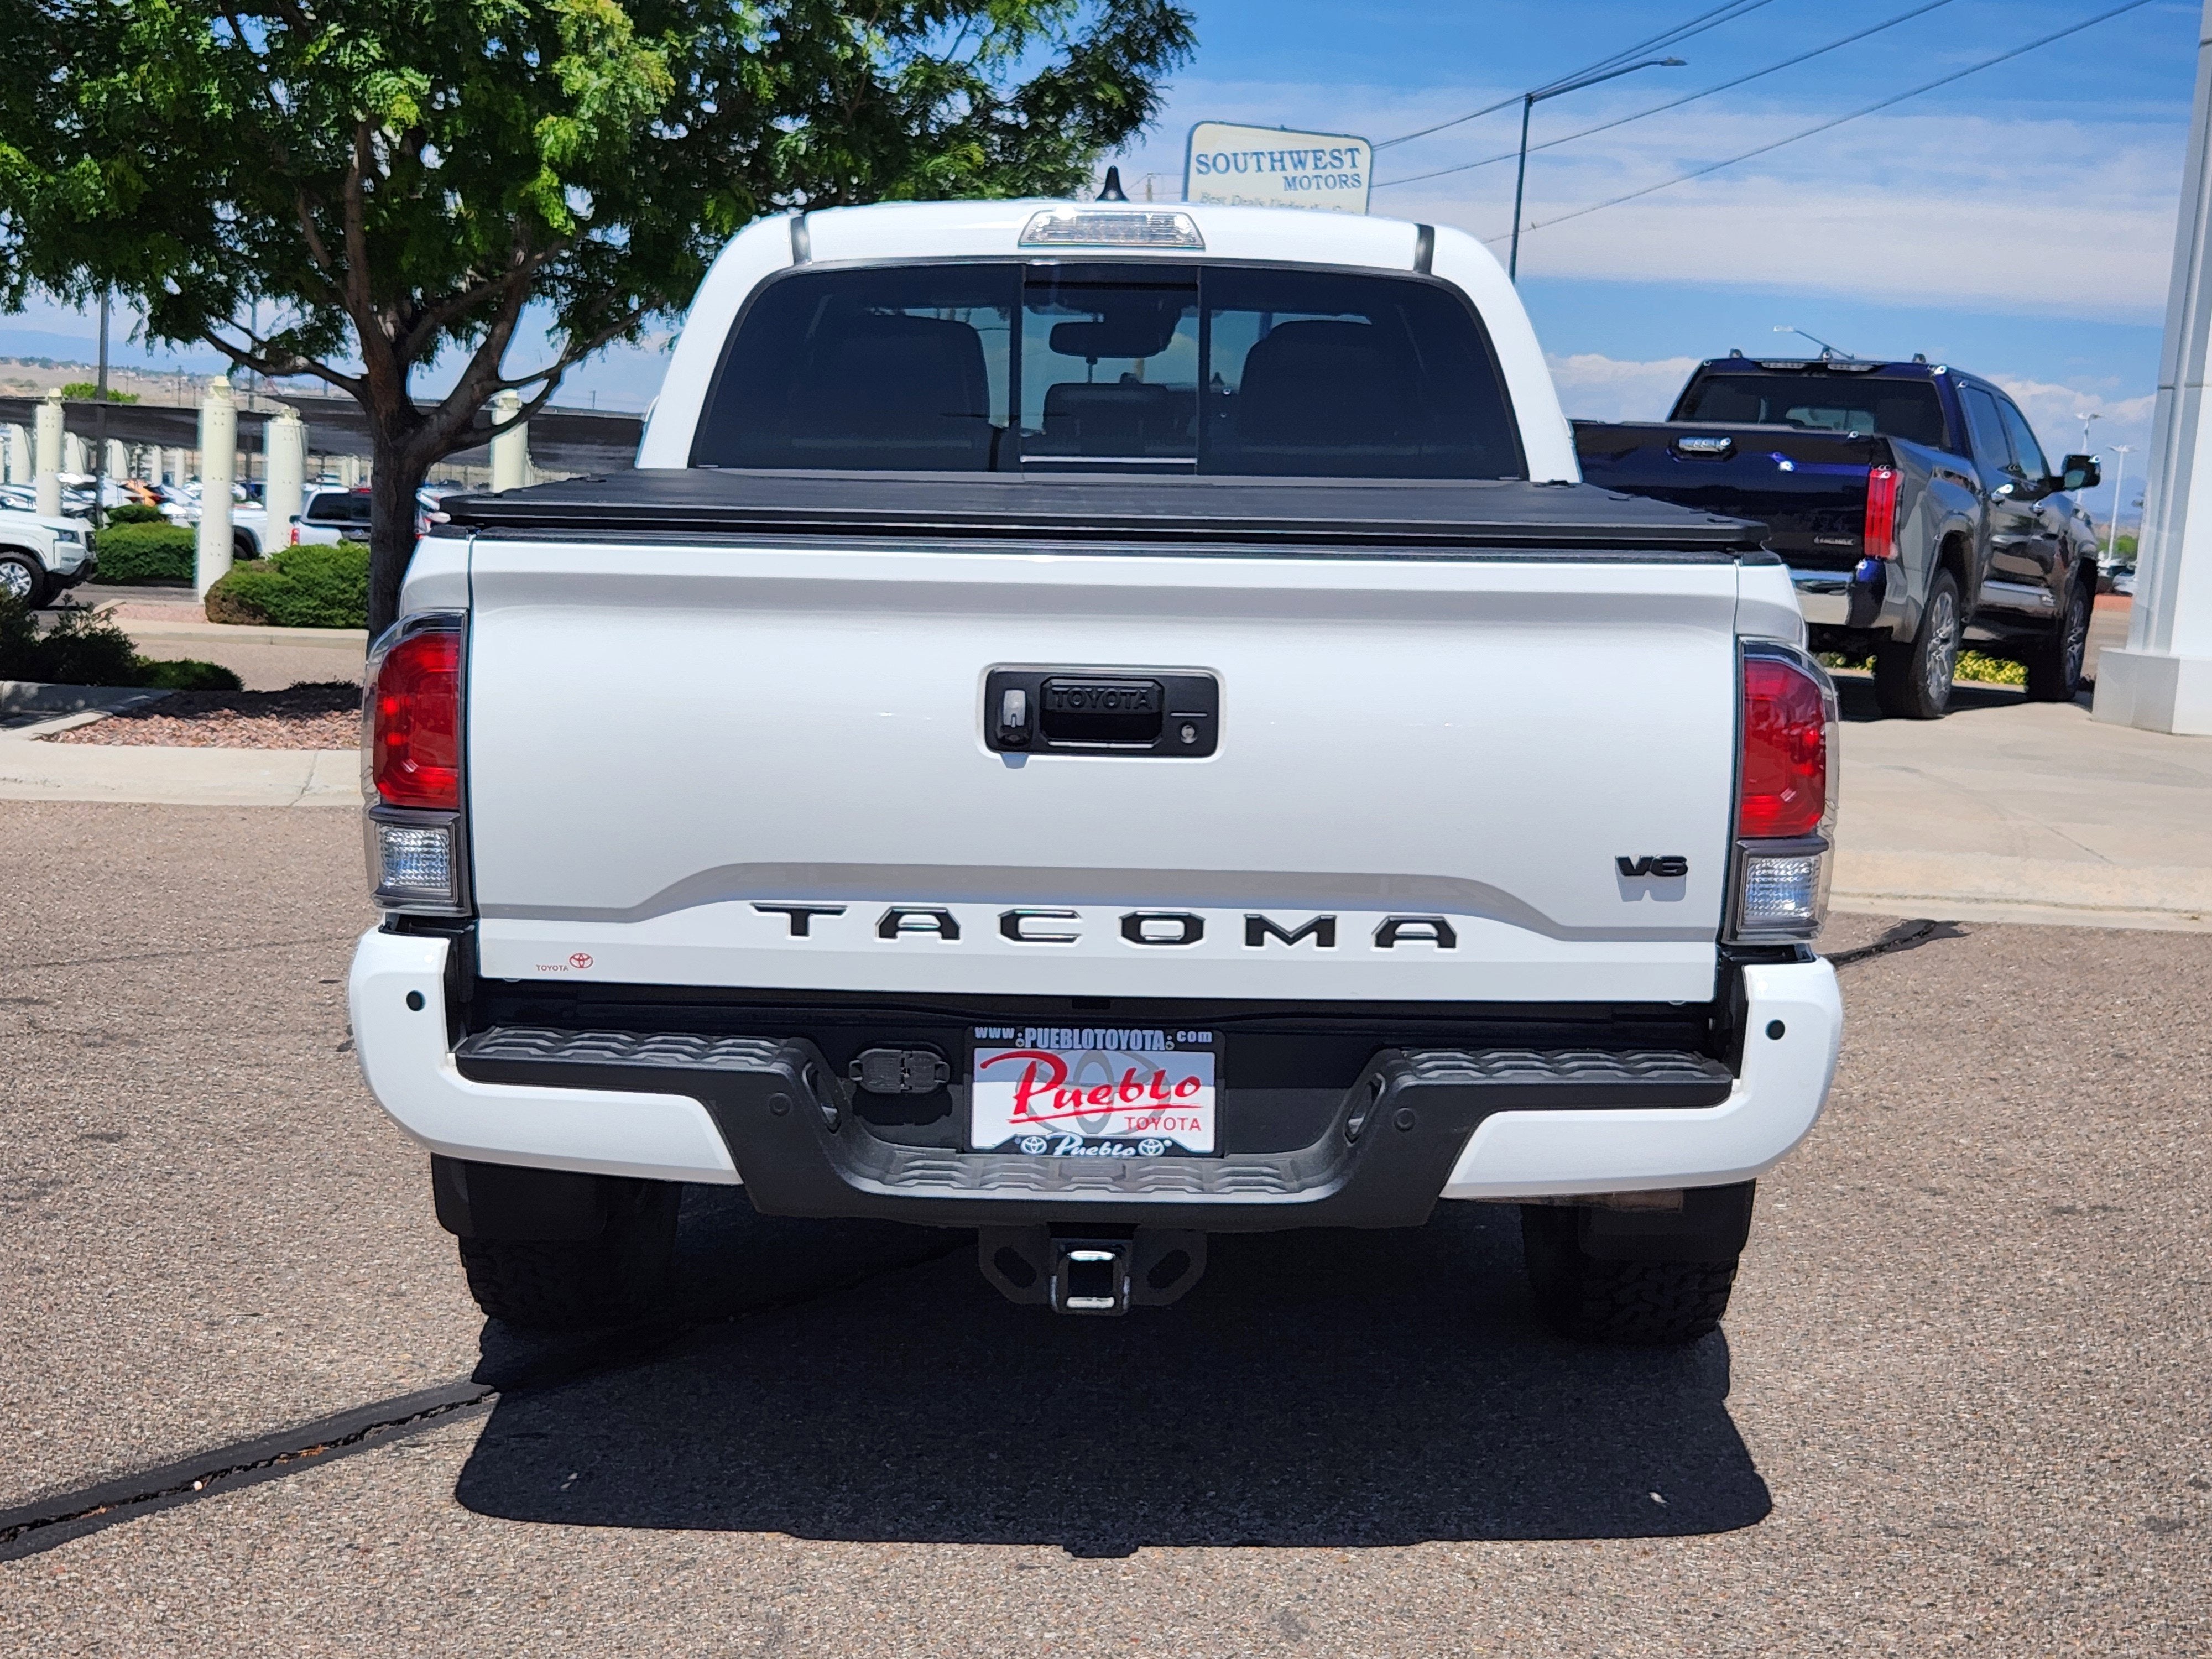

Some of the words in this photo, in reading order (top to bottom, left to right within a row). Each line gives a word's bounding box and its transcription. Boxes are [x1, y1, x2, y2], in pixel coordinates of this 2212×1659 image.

[1196, 148, 1362, 175] SOUTHWEST
[1282, 173, 1362, 191] MOTORS
[1052, 687, 1152, 711] TOYOTA
[1615, 855, 1688, 877] V6
[749, 901, 1458, 950] TACOMA
[980, 1050, 1201, 1115] Pueblo
[1124, 1116, 1202, 1131] TOYOTA
[1047, 1131, 1136, 1156] Pueblo
